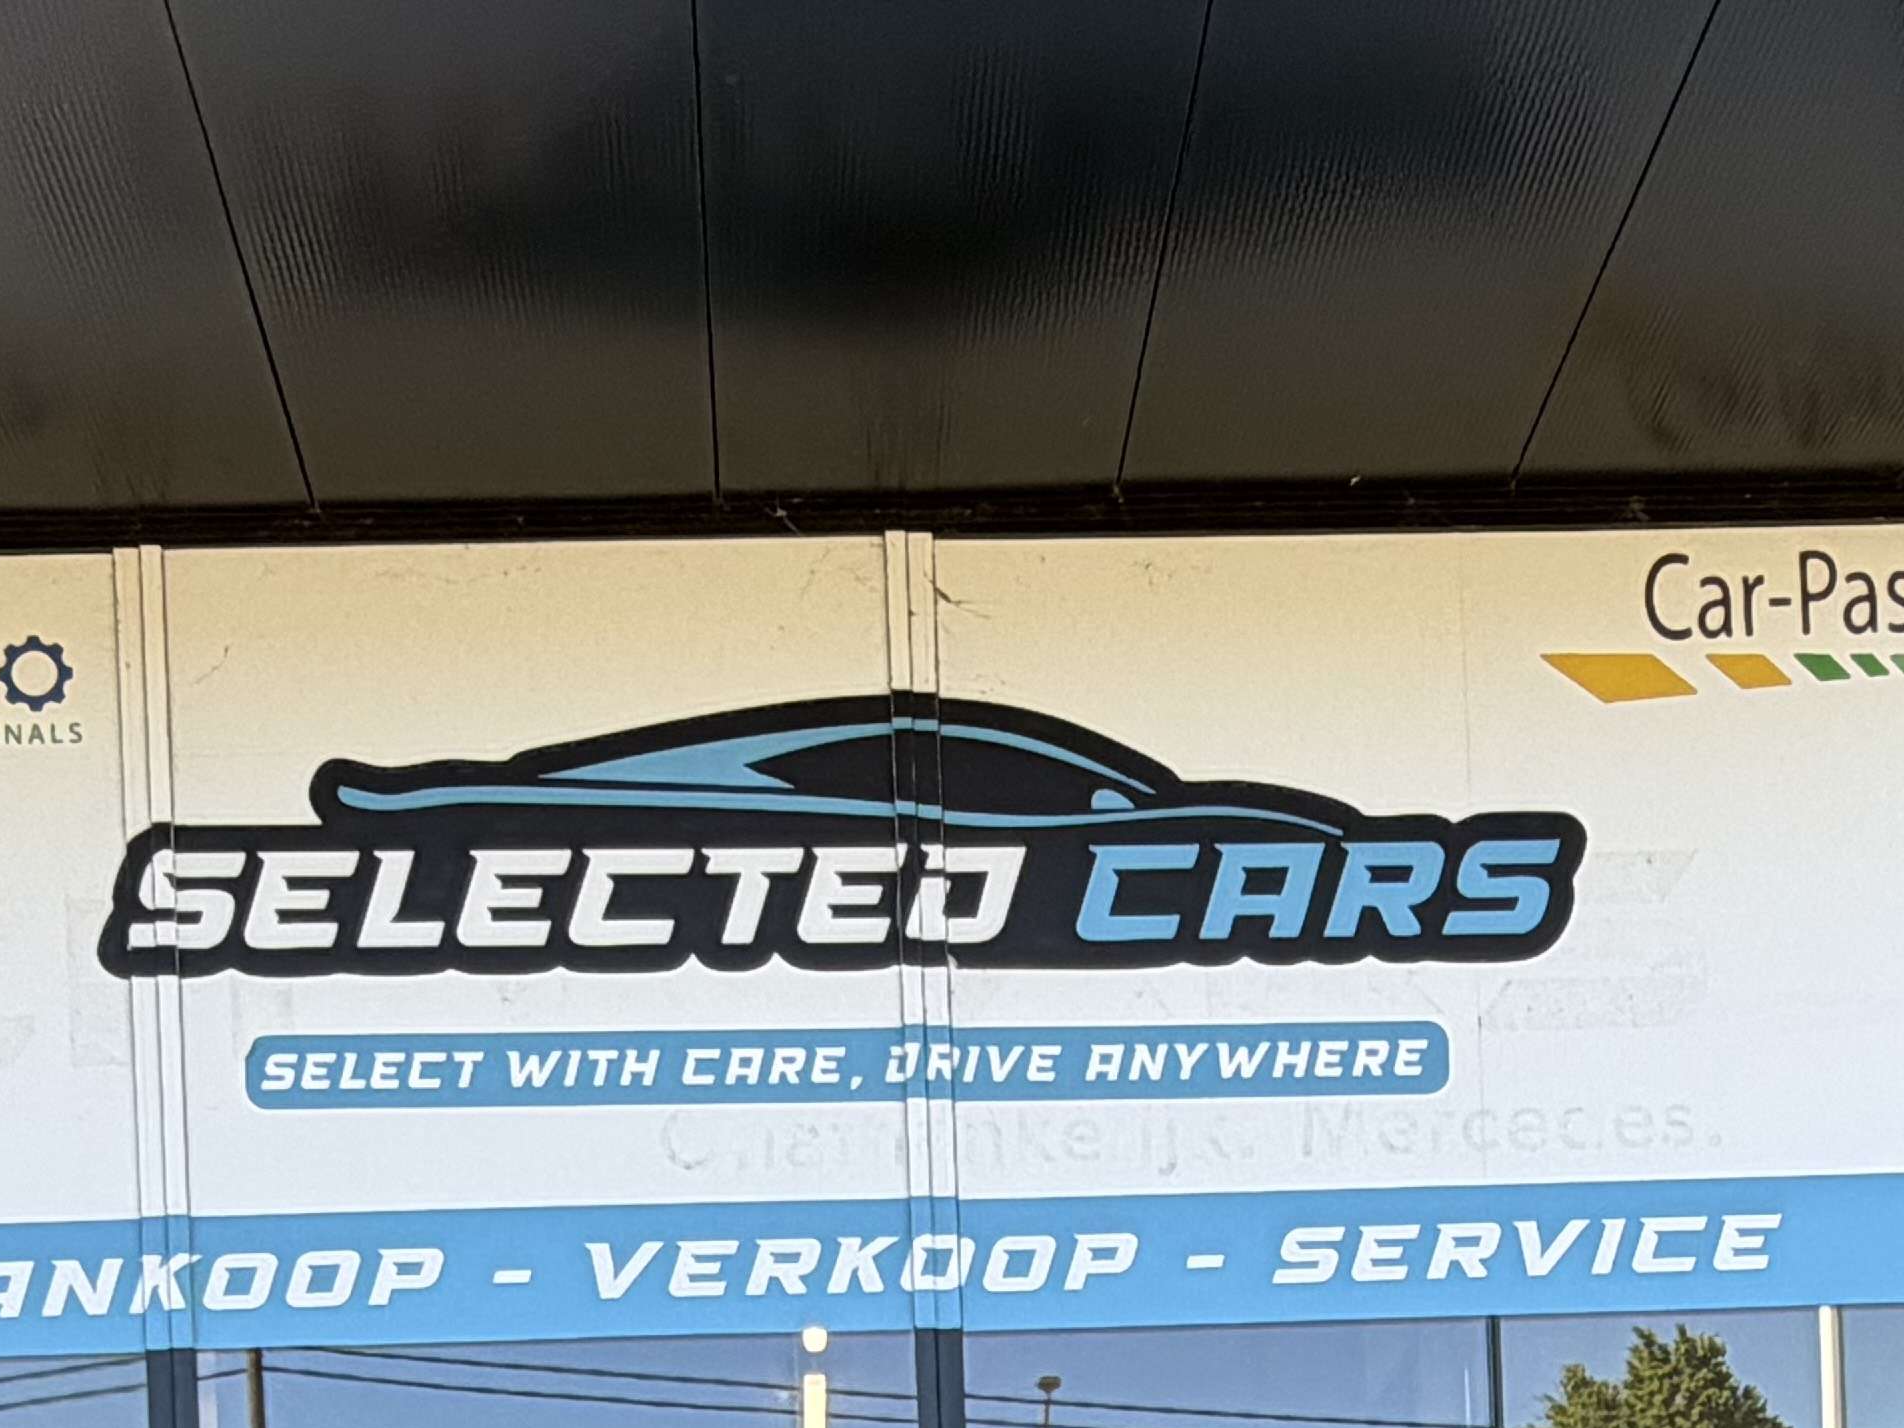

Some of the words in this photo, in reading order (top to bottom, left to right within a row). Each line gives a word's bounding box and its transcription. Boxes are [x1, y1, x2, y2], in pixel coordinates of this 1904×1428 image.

[126, 842, 1027, 952] SELECTED
[1074, 836, 1562, 942] CARS
[259, 1049, 485, 1092] SELECT
[506, 1047, 661, 1091] WITH
[681, 1045, 862, 1092] CARE,
[884, 1042, 1063, 1086] DRIVE
[1084, 1037, 1429, 1083] ANYWHERE
[582, 1229, 1142, 1302] VERKOOP
[1271, 1211, 1785, 1286] SERVICE
